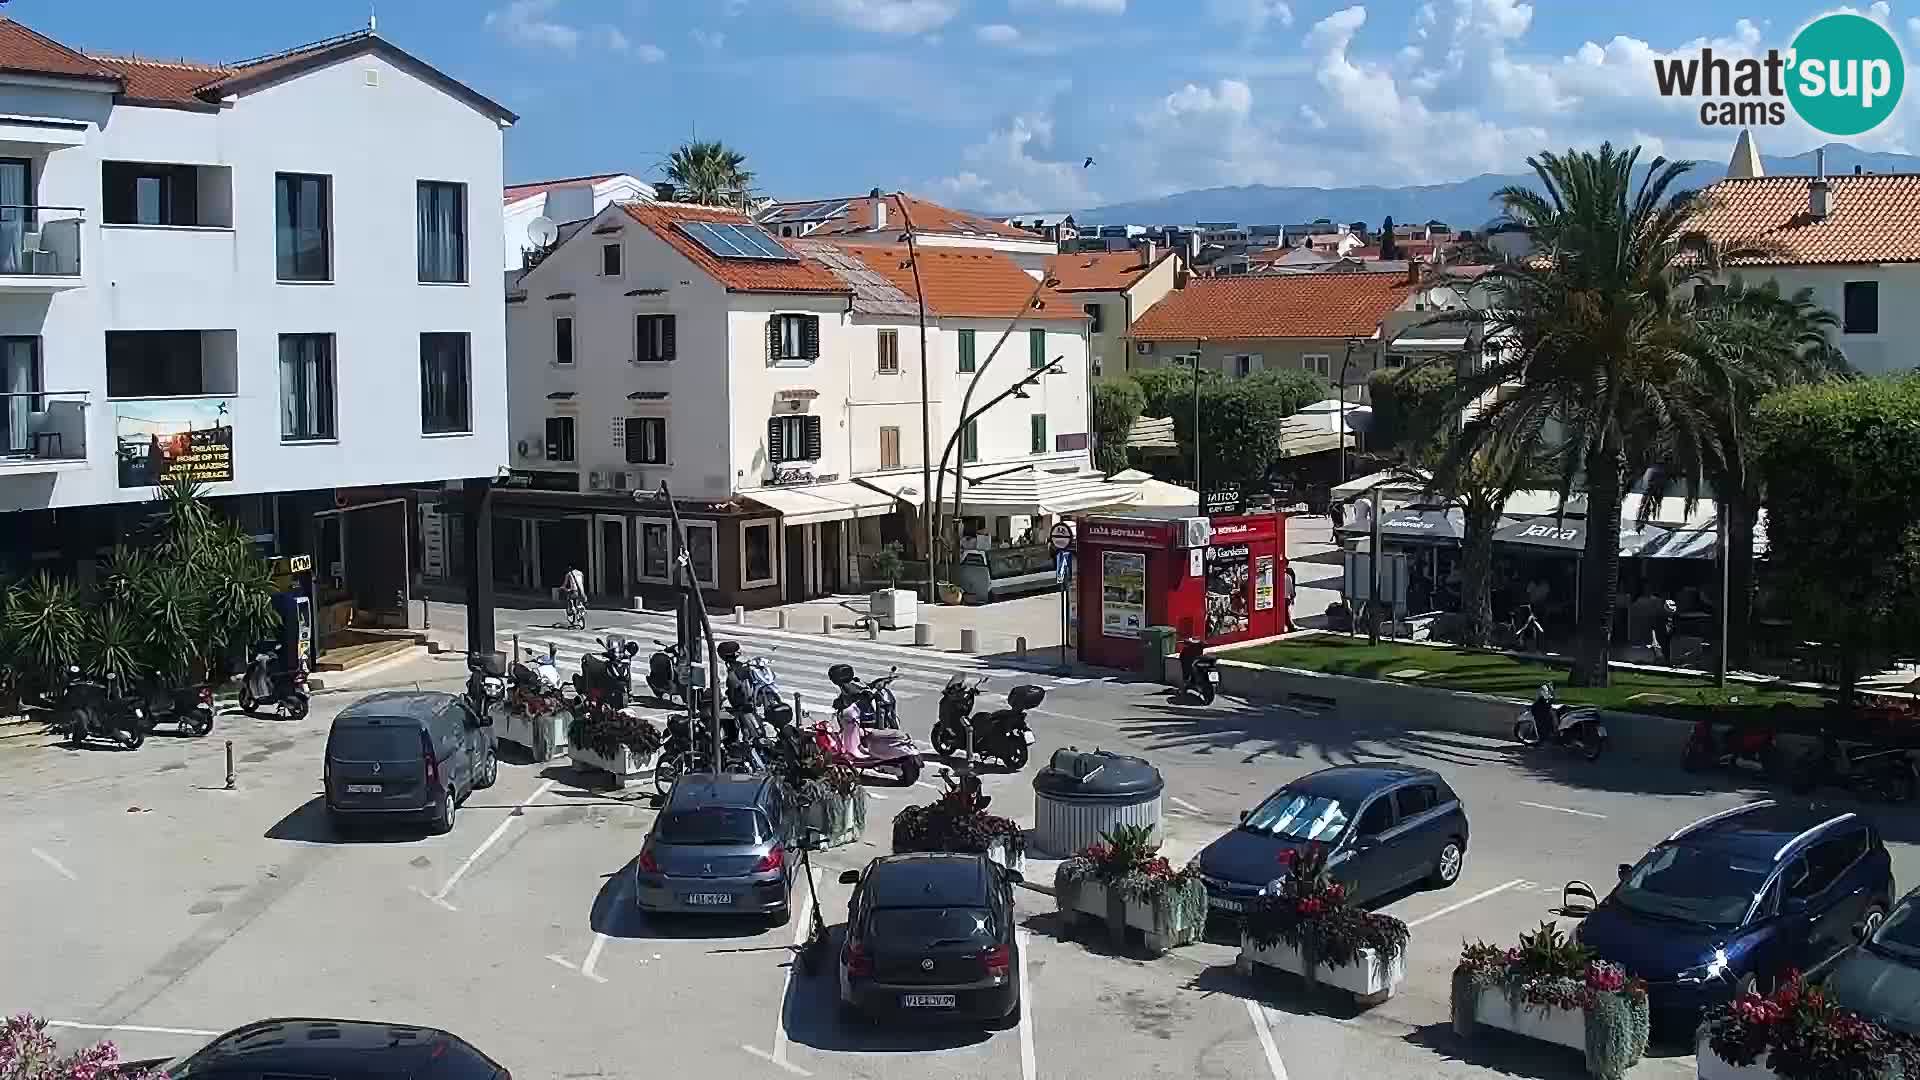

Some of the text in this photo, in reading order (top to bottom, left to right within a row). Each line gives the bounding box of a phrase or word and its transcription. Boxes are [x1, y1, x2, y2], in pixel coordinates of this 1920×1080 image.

[176, 454, 201, 463] HOME
[213, 452, 230, 461] THE
[169, 462, 230, 472] MOST AMAZING
[1208, 491, 1239, 502] TATTOO
[293, 557, 310, 570] ATM
